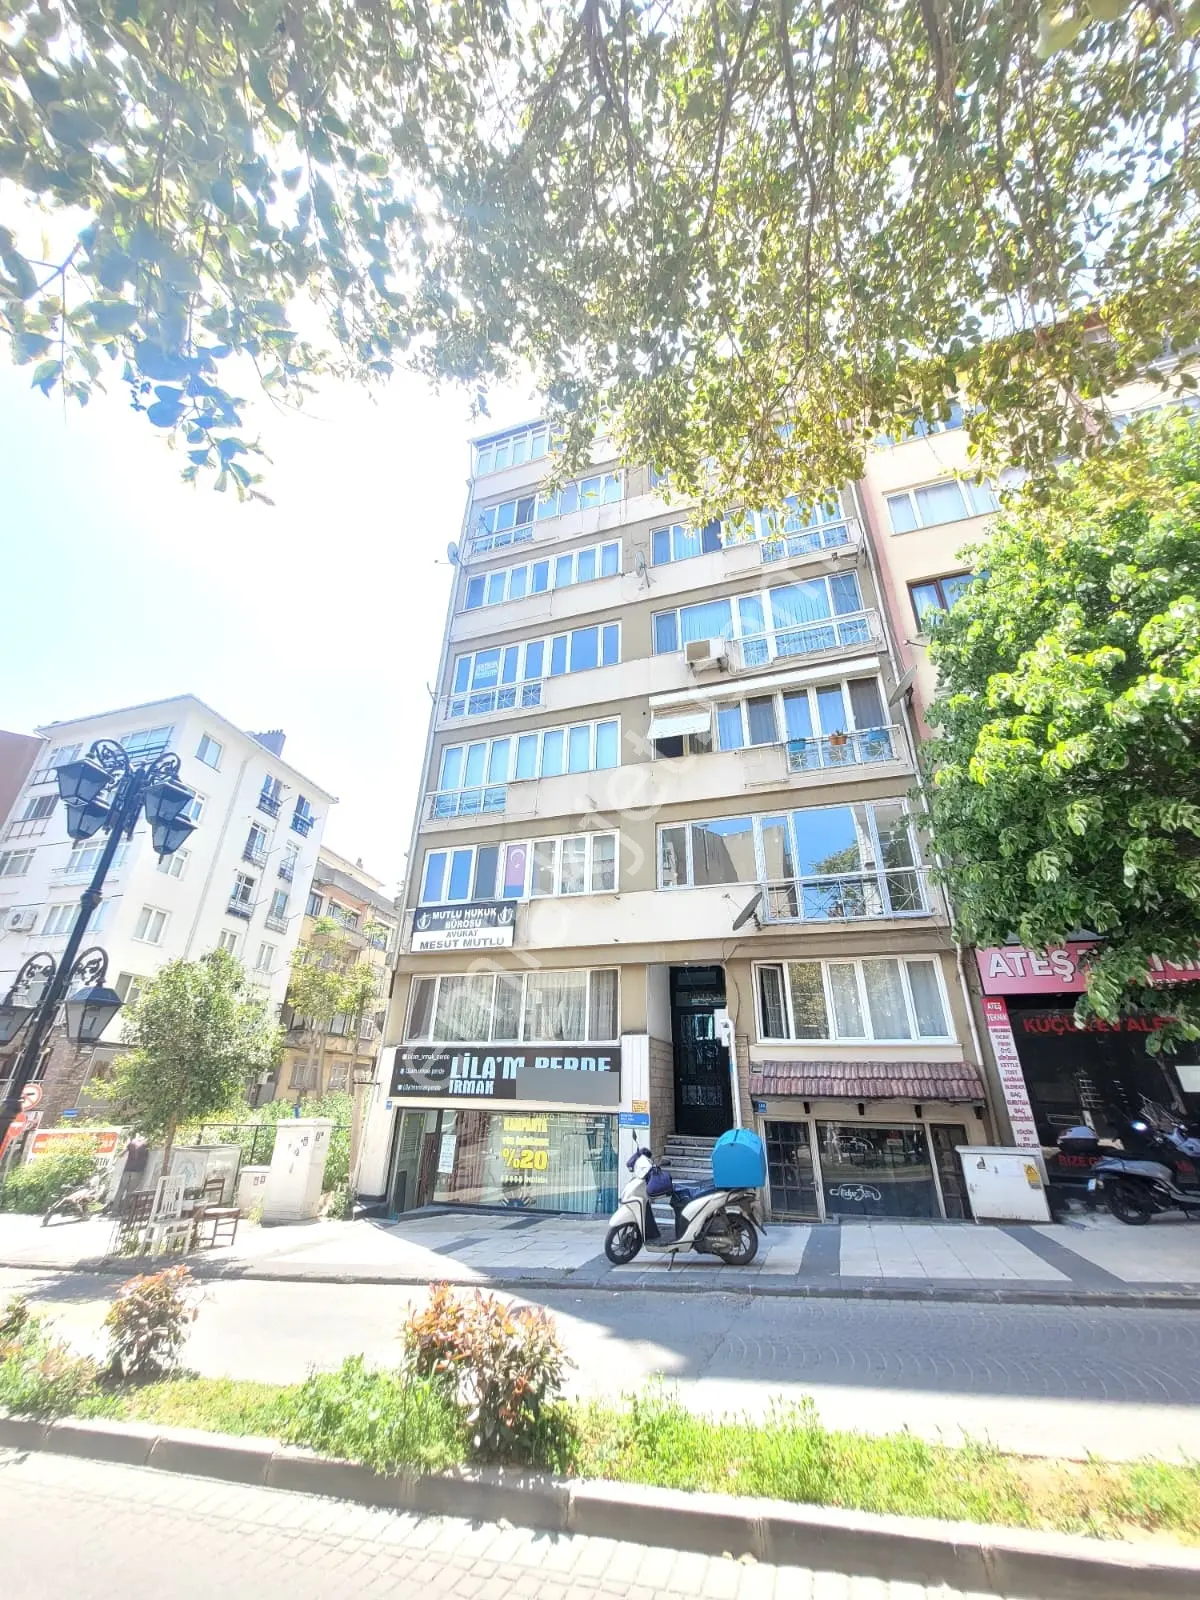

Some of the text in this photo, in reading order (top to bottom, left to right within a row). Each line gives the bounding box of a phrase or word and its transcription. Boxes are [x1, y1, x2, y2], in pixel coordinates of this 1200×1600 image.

[432, 908, 497, 920] MUTLU HUKUK
[445, 918, 482, 929] BÜROSU
[446, 929, 478, 938] AVUKAT
[419, 937, 505, 950] MESUT MUTLU
[988, 949, 1076, 983] ATEŞ
[502, 1147, 549, 1171] %20
